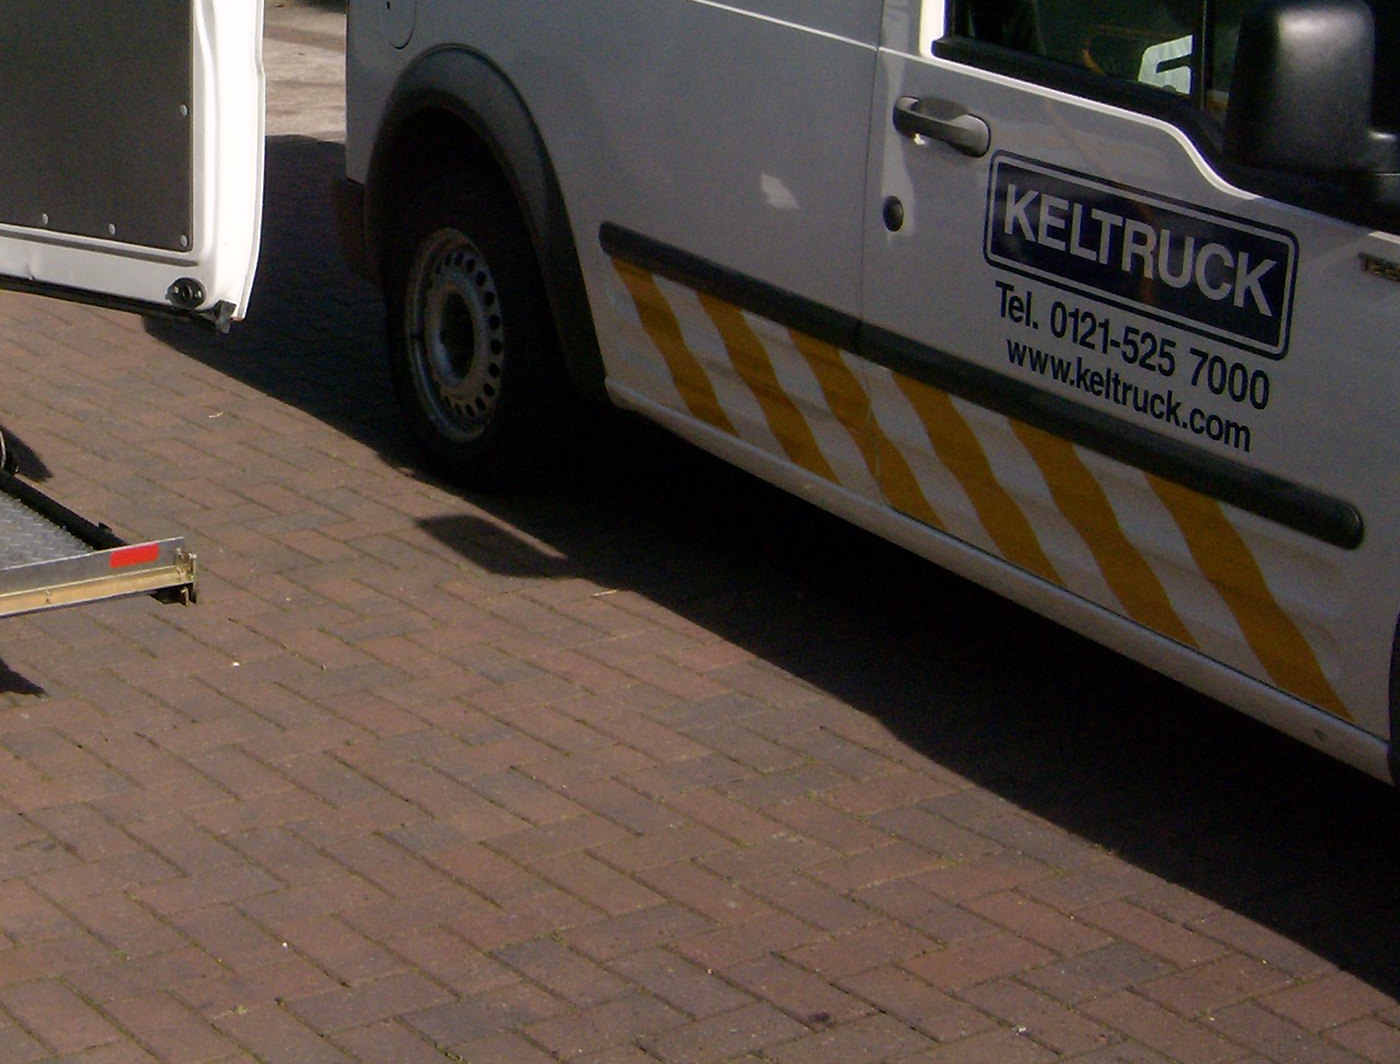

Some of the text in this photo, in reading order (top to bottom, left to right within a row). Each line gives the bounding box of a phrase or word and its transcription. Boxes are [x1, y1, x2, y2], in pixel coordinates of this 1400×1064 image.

[1003, 184, 1277, 318] KELTRUCK
[995, 280, 1271, 411] Tel. 0121-525 7000
[1006, 338, 1252, 453] www.keltruck.com
